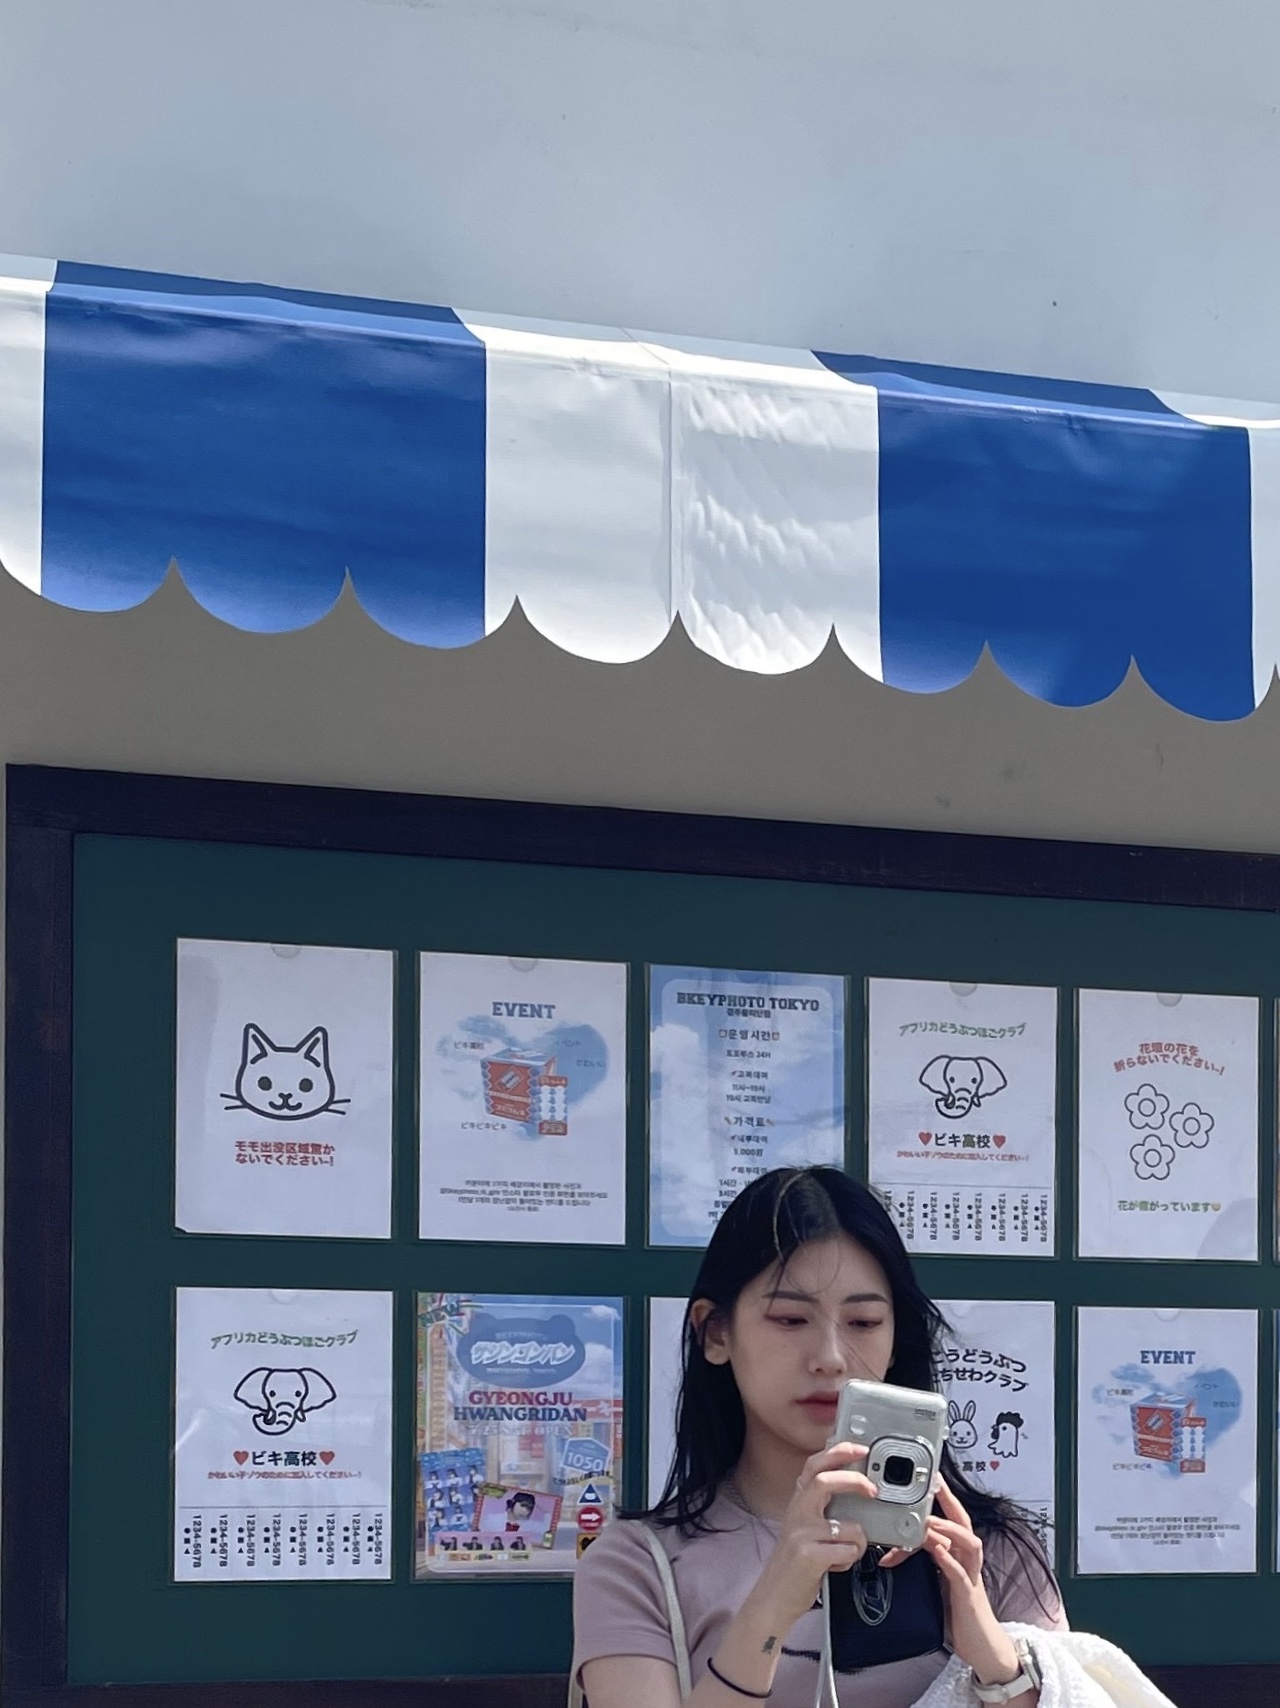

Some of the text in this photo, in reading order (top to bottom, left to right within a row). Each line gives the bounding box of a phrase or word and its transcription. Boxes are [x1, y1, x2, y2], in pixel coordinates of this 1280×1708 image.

[492, 1001, 556, 1019] EVENT
[676, 991, 820, 1012] BKEYPHOTO TOKYO
[935, 1133, 991, 1149] ビキ高校
[1140, 1350, 1196, 1365] EVENT
[454, 1407, 587, 1422] HWANGRIDAN
[469, 1390, 572, 1406] GYEONGJU
[252, 1451, 317, 1467] ビキ高校
[567, 1451, 603, 1470] 1050
[193, 1515, 202, 1568] 1234-5678
[219, 1514, 228, 1567] 1234-5678
[246, 1514, 256, 1567] 1234-5678
[272, 1514, 281, 1566] 1234-5678
[298, 1513, 308, 1566] 1234-5678
[326, 1513, 335, 1566] 1234-5678
[352, 1513, 361, 1565] 1234-5678
[374, 1513, 383, 1565] 1234-5678
